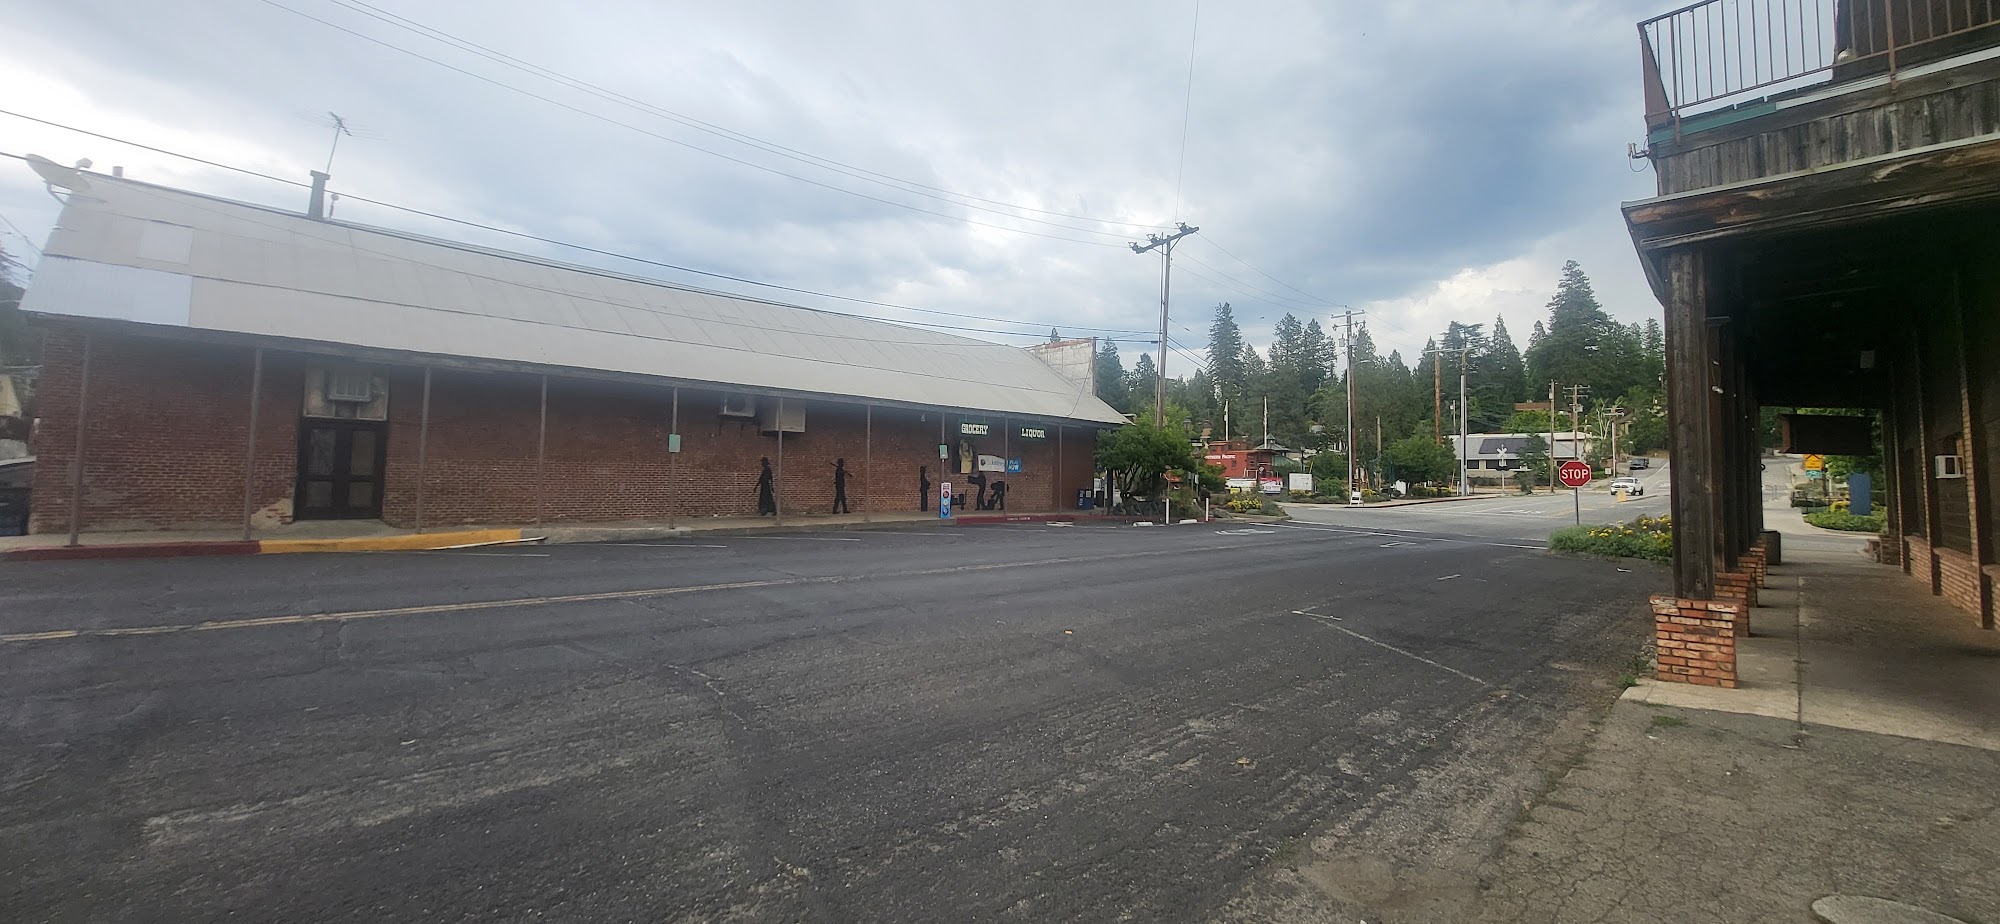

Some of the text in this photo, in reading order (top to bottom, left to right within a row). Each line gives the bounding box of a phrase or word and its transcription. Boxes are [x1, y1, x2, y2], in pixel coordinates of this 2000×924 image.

[961, 423, 989, 435] GROCERY
[1021, 428, 1046, 438] LIQUOR
[1561, 469, 1589, 479] STOP
